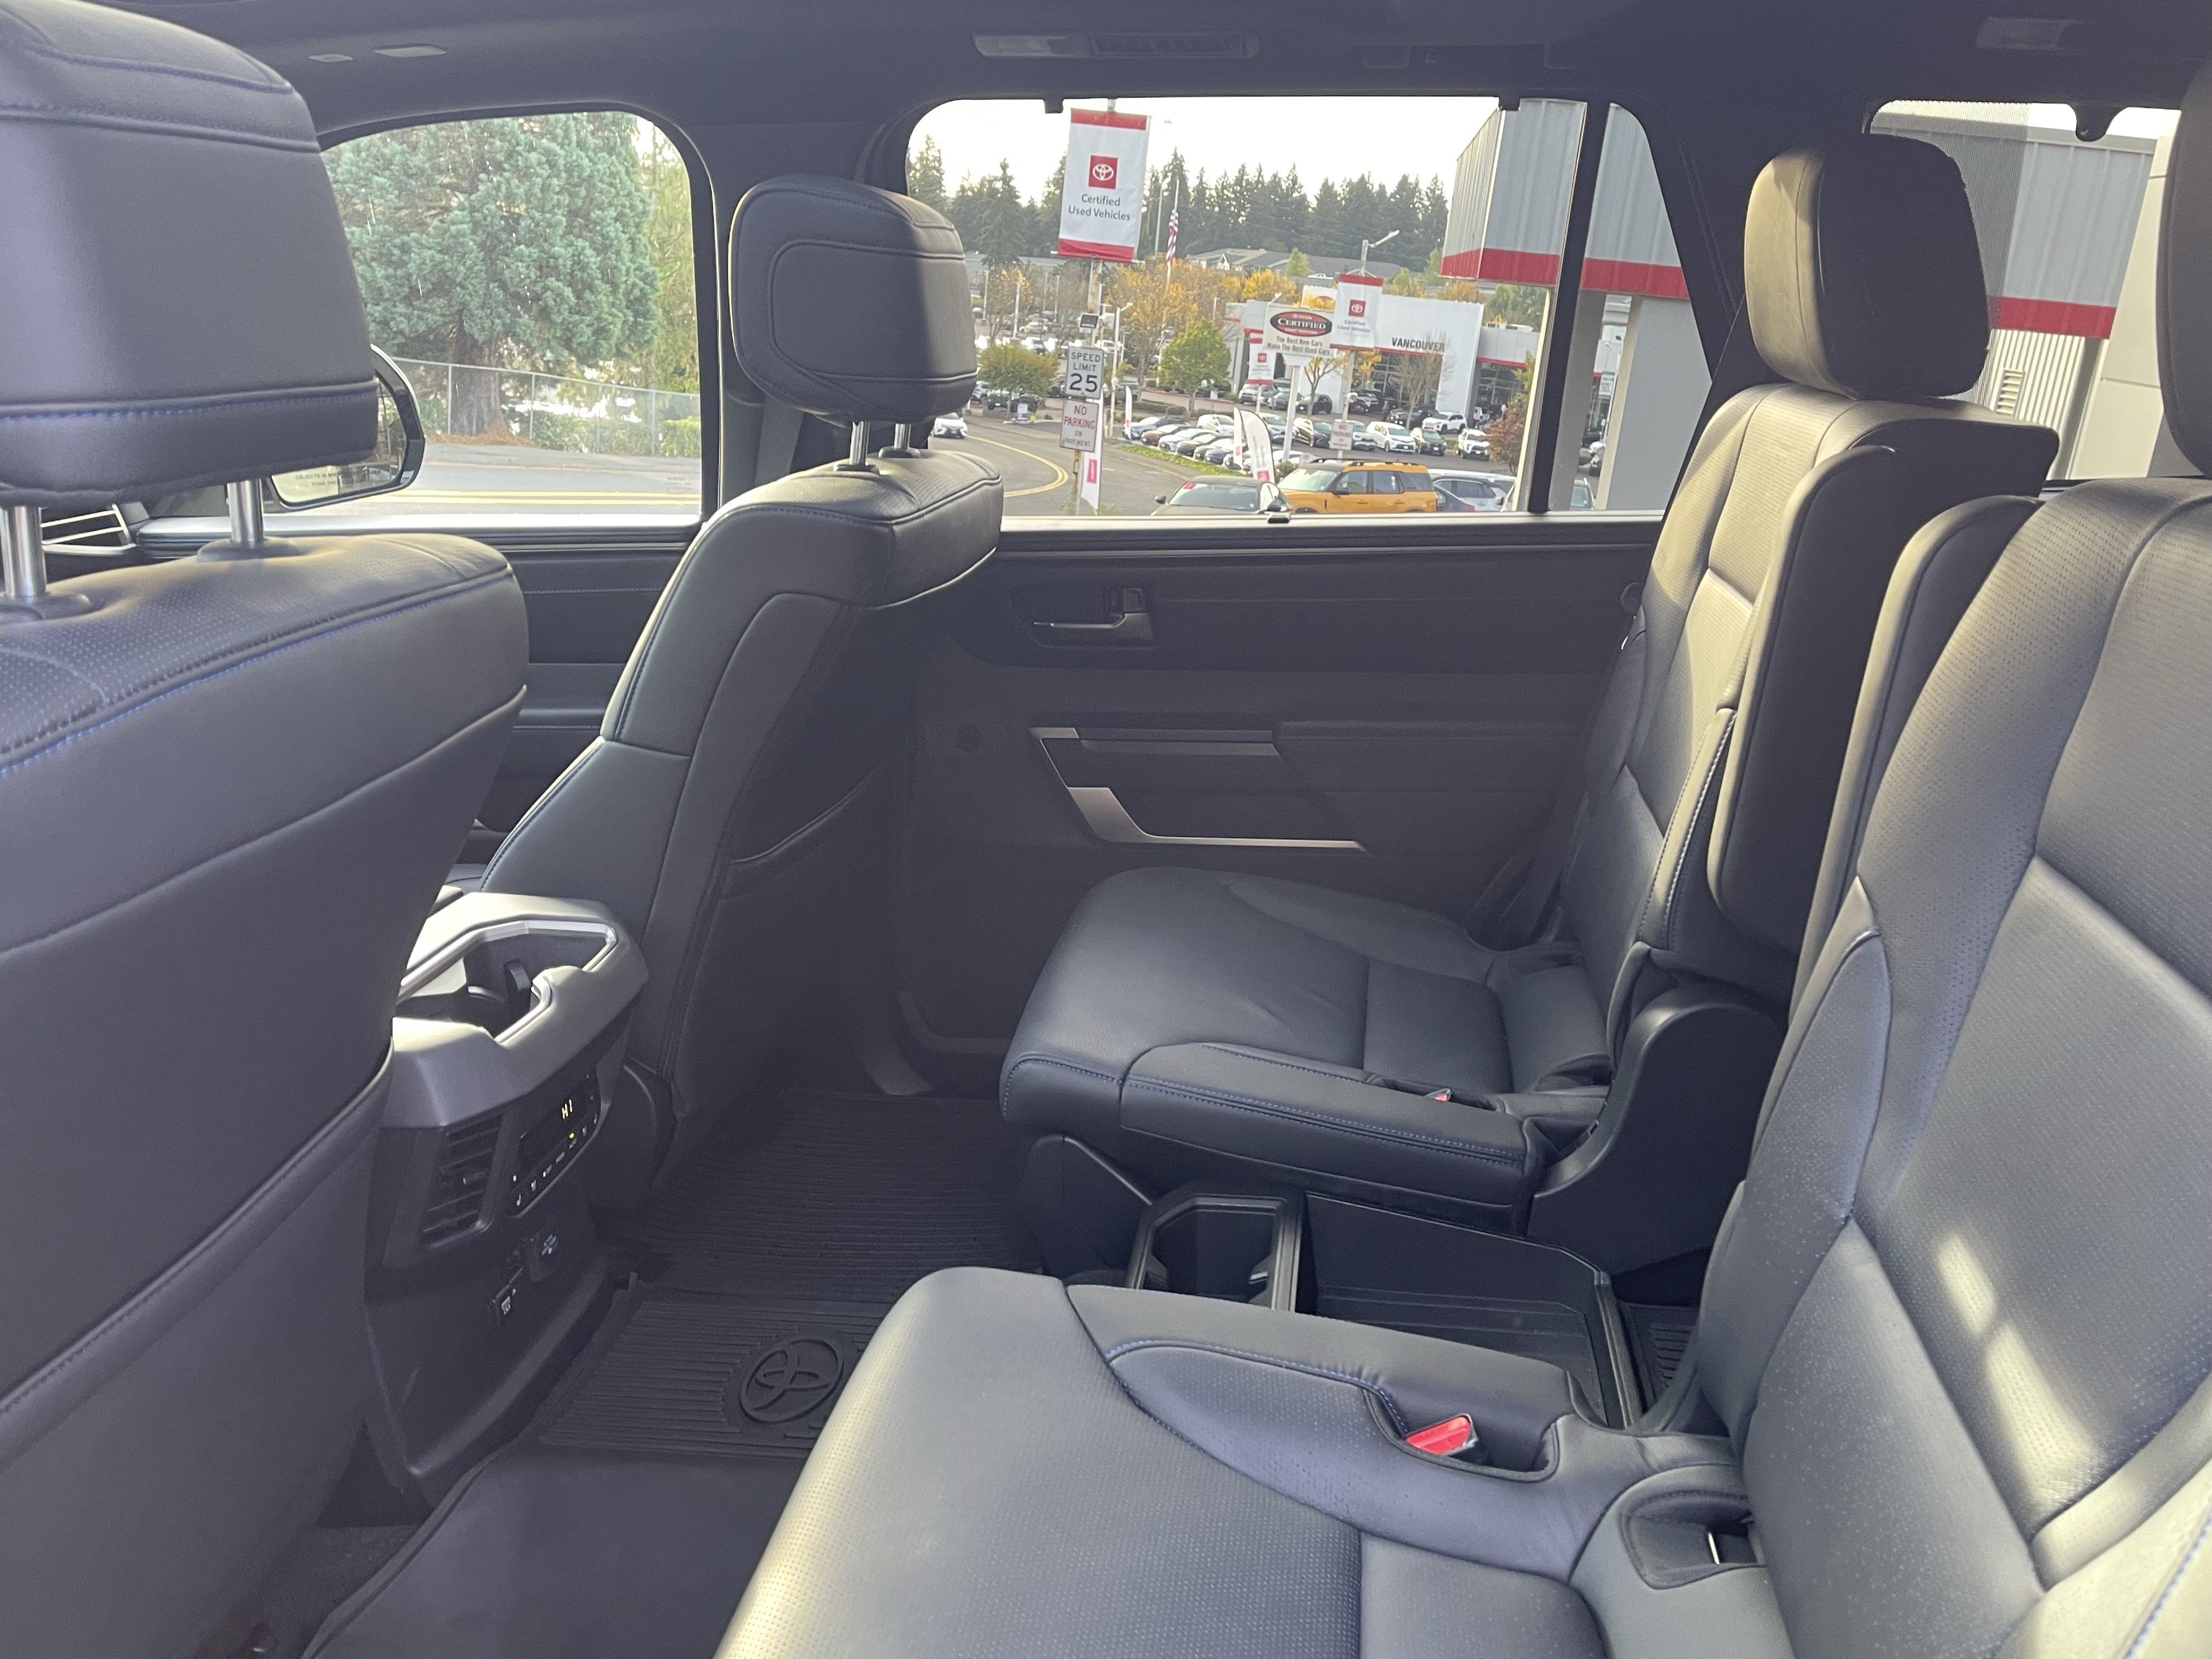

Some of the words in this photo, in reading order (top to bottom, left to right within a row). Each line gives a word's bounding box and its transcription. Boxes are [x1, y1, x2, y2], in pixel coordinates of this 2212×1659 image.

[1081, 194, 1120, 206] Certified
[1069, 205, 1091, 216] Used
[1093, 207, 1130, 221] Vehicles
[1392, 337, 1445, 352] VANCOUVER
[1071, 352, 1101, 363] SPEED
[1073, 363, 1097, 372] LIMIT
[1069, 373, 1098, 392] 25
[1074, 405, 1087, 415] NO
[1063, 416, 1095, 430] PARKING
[561, 1099, 573, 1119] HI
